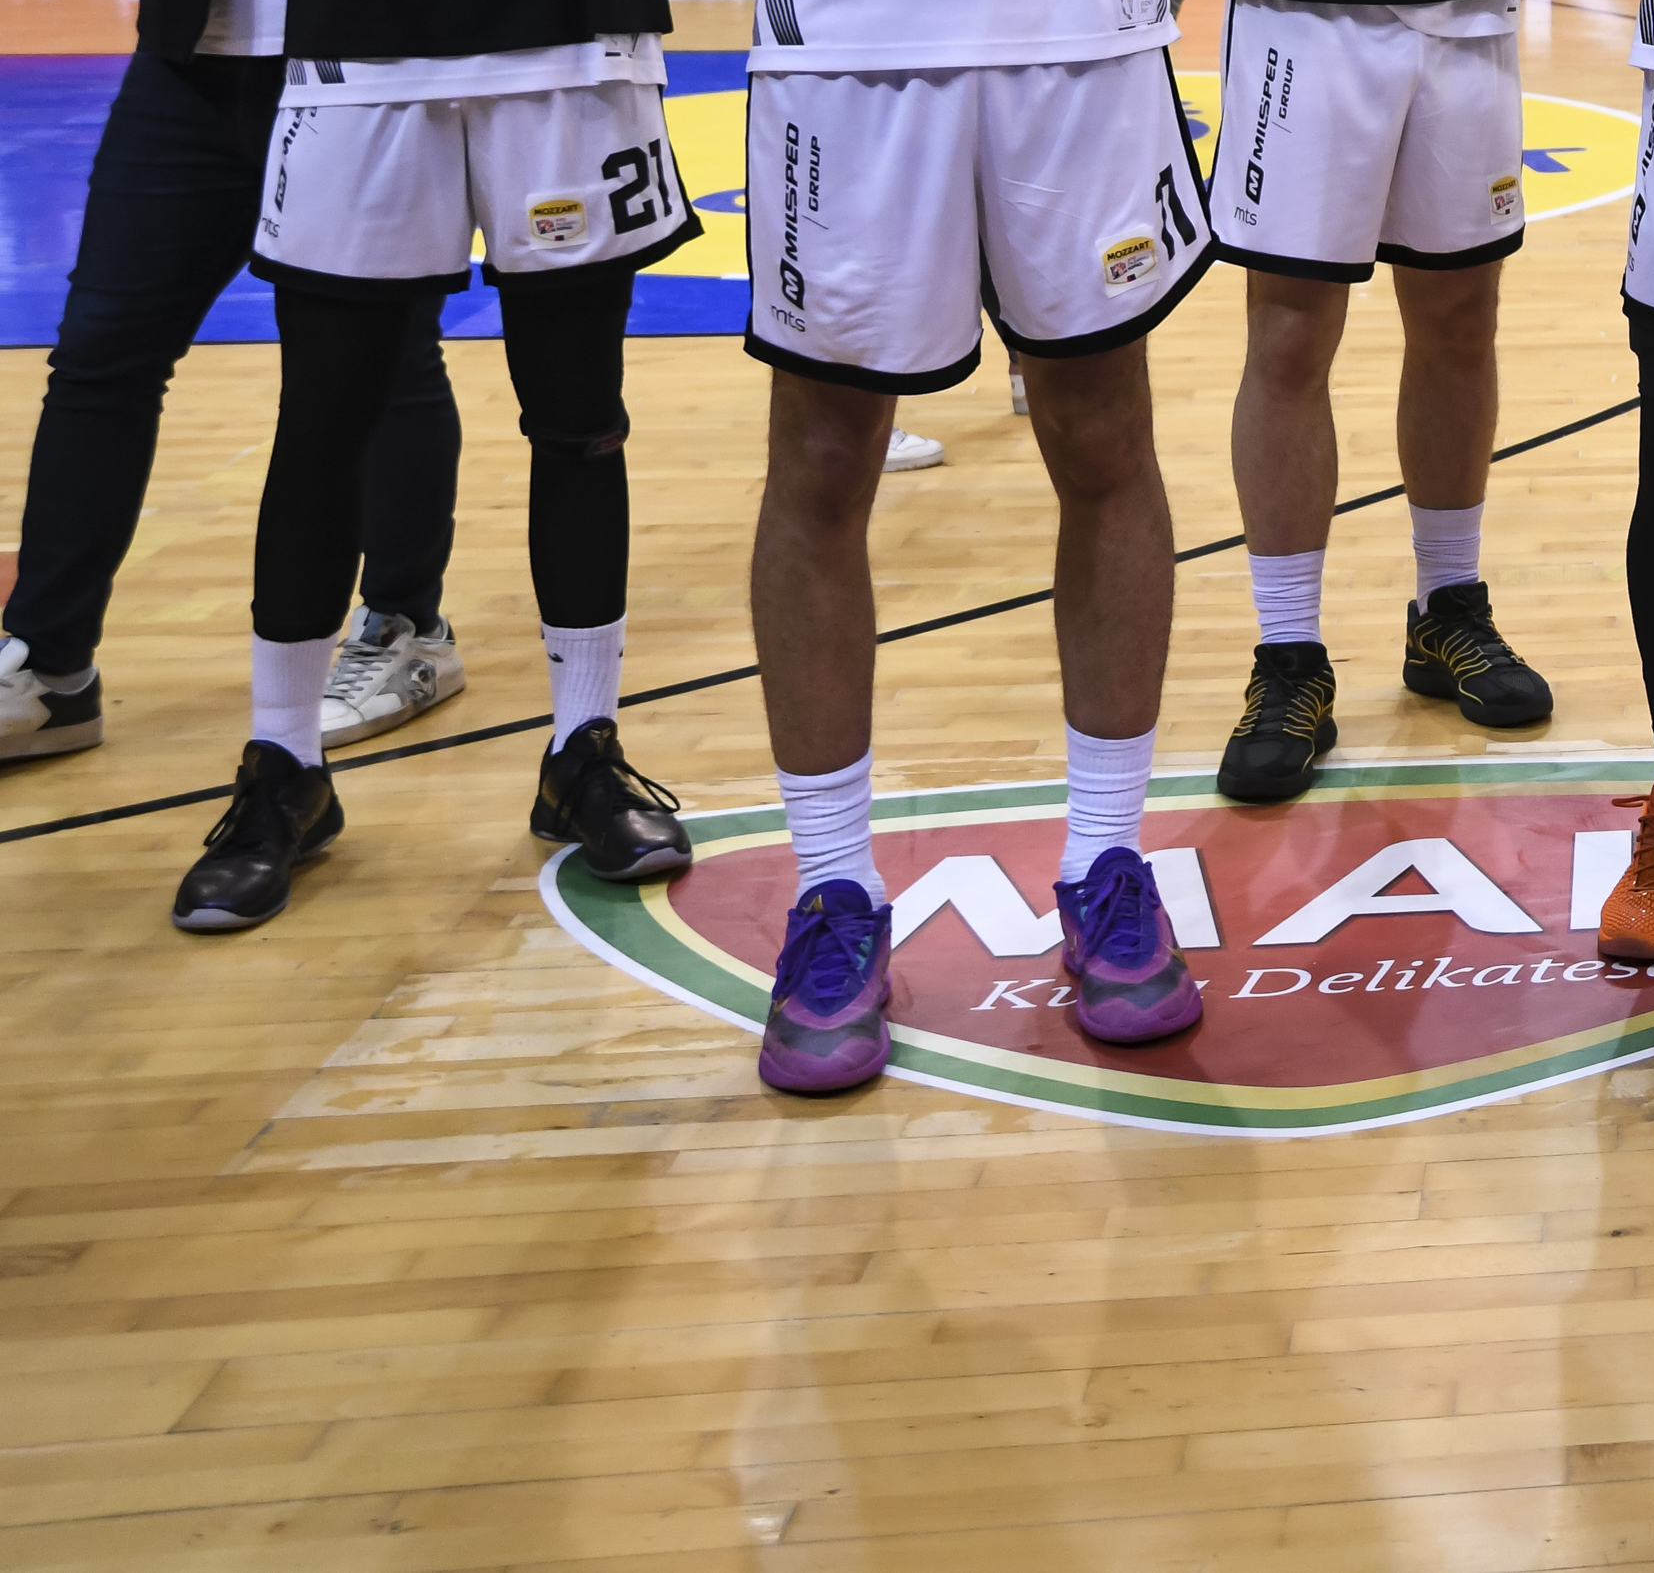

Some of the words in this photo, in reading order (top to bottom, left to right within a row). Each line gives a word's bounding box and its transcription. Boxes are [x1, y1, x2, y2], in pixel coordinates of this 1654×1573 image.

[1254, 47, 1279, 161] MILSPED
[1278, 57, 1294, 120] GROUP
[600, 138, 673, 235] 21
[781, 122, 800, 263] MILSPED
[806, 134, 821, 213] GROUP
[1107, 240, 1150, 262] MOZZART
[1233, 205, 1258, 227] mts
[770, 303, 807, 333] mts
